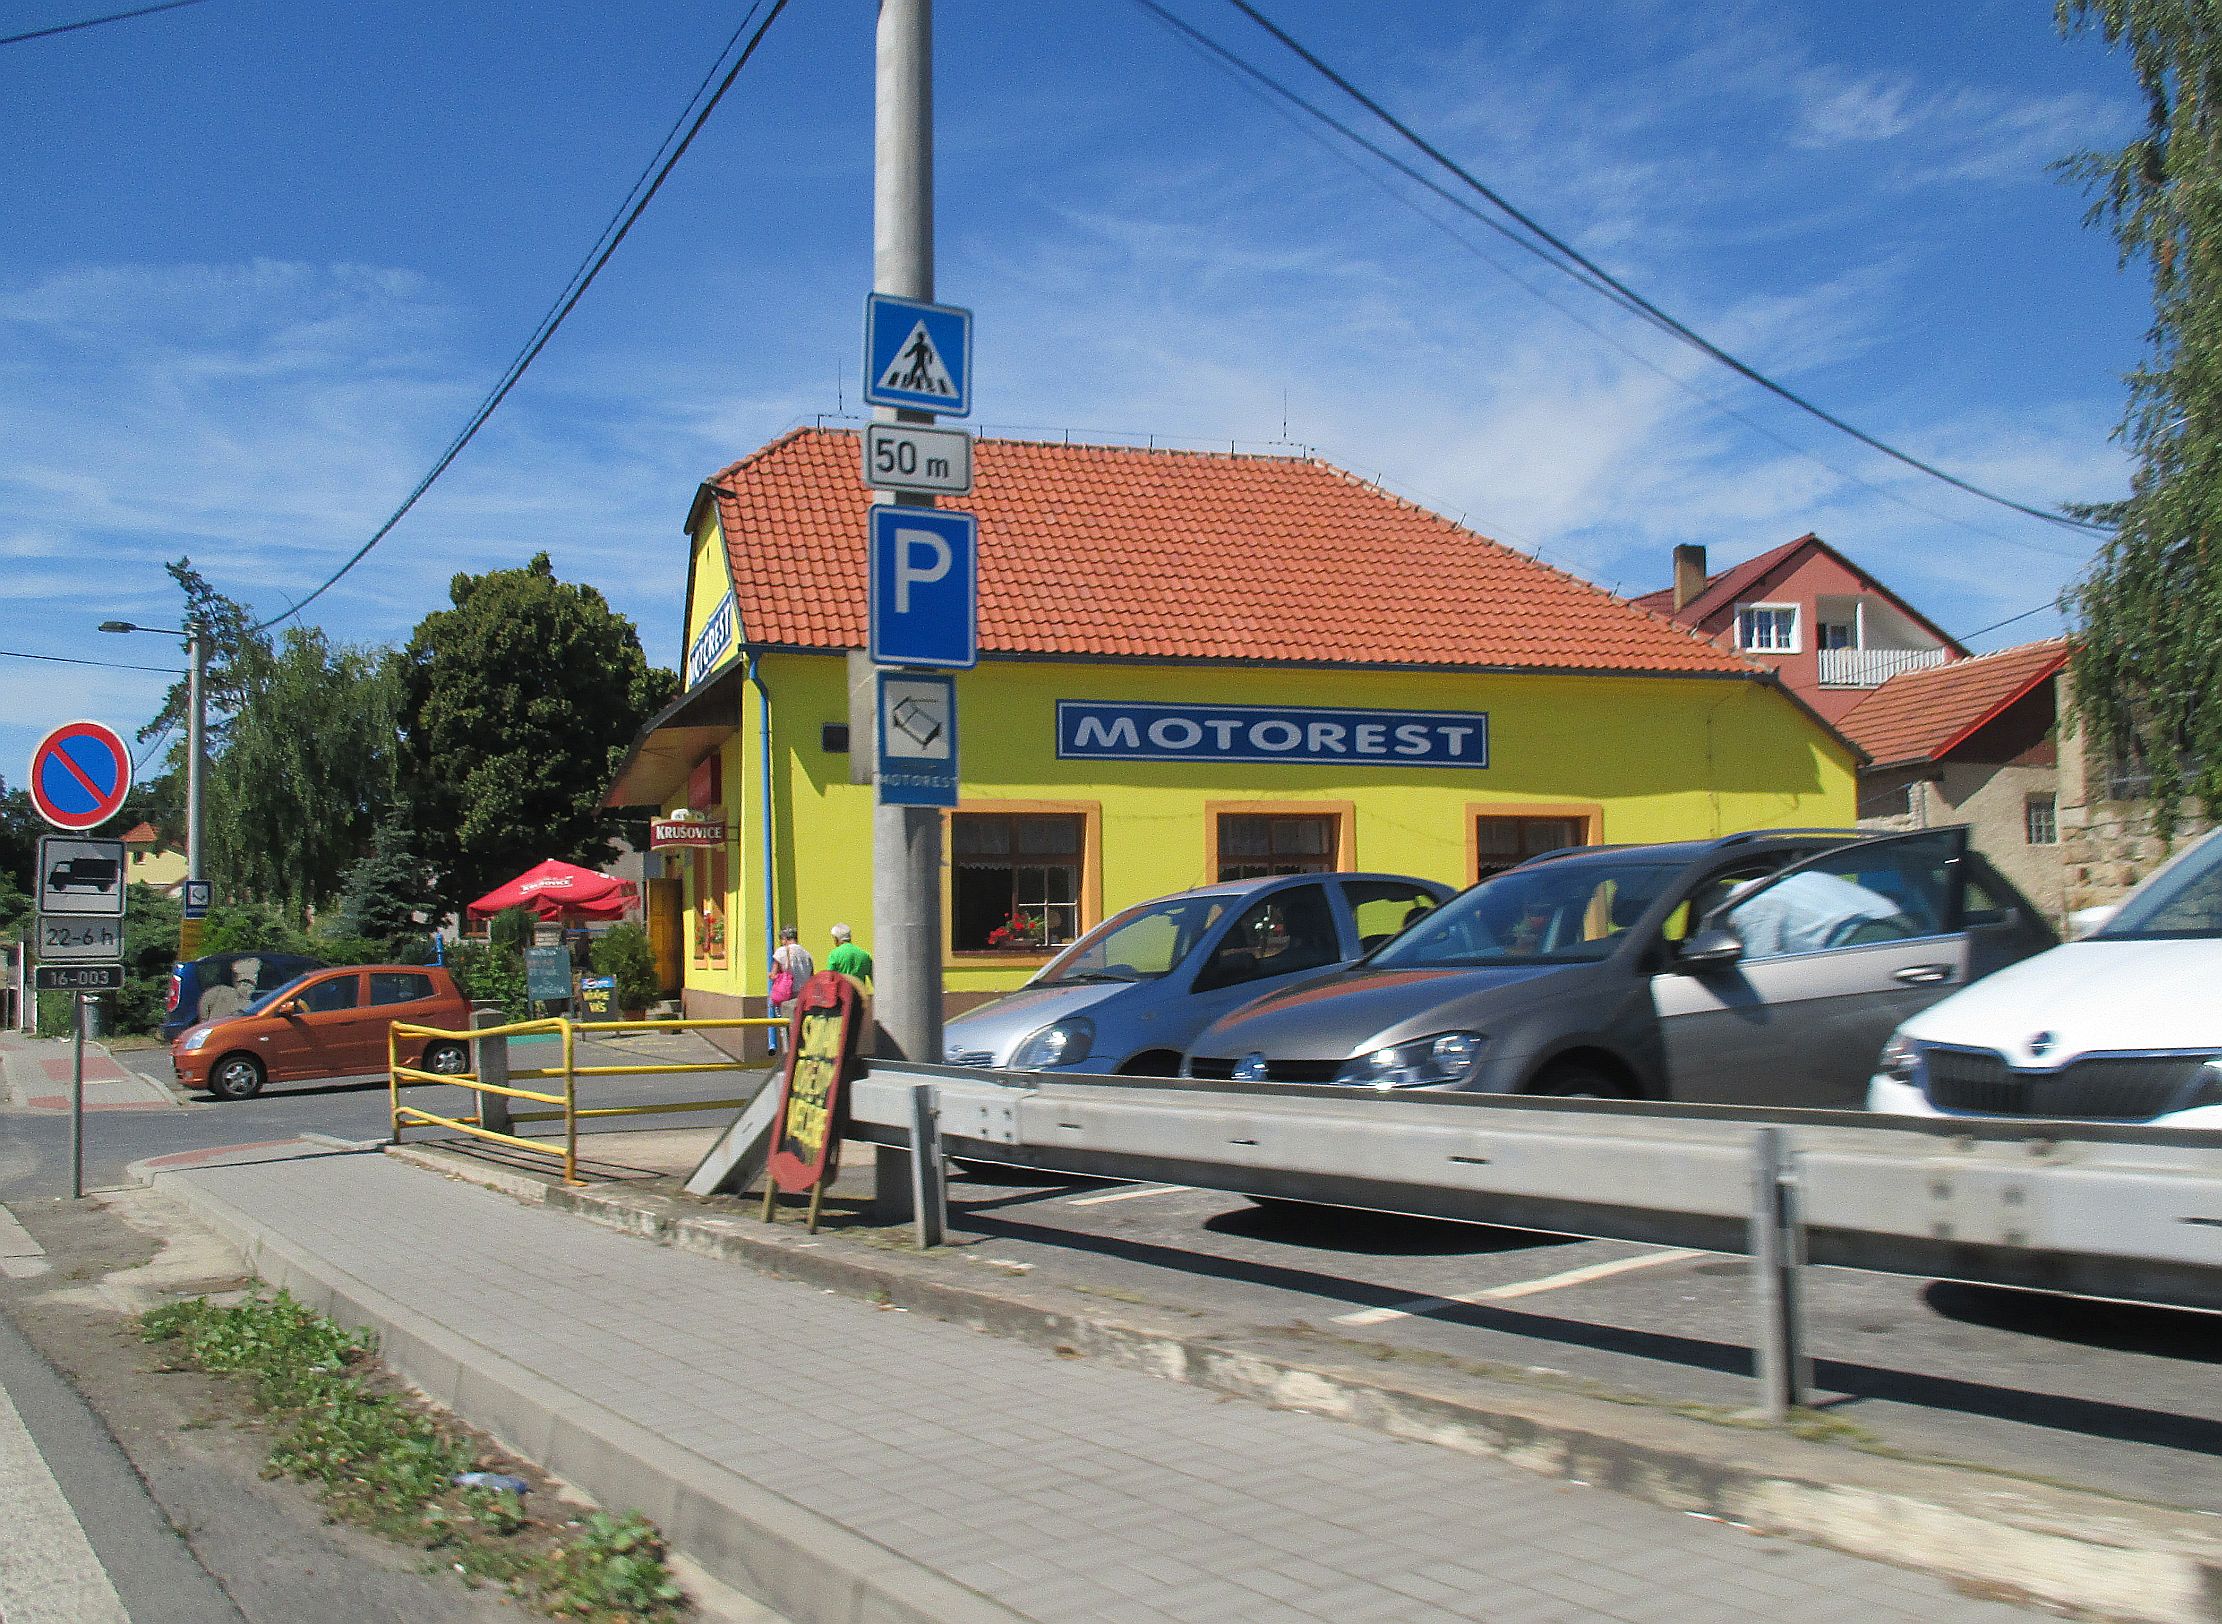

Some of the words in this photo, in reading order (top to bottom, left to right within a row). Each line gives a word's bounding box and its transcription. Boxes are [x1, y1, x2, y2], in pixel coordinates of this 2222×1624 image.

[876, 438, 917, 475] 50
[927, 457, 948, 478] m
[894, 528, 952, 613] P
[1074, 716, 1473, 755] MOTOREST
[47, 928, 94, 945] 22-6
[102, 927, 114, 945] h
[50, 970, 109, 985] 16-003
